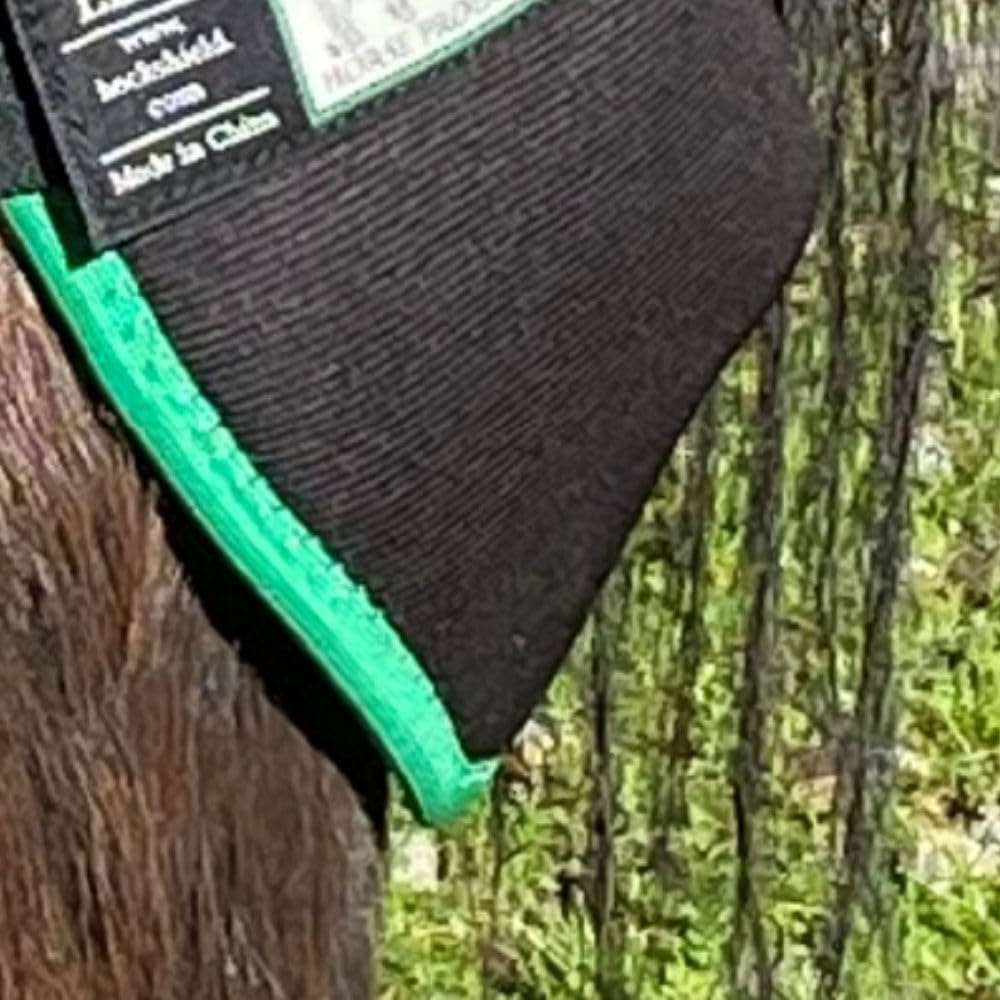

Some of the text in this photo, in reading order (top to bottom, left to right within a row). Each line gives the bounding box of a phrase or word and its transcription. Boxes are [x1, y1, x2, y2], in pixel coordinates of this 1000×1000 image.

[107, 110, 281, 196] Made in China
